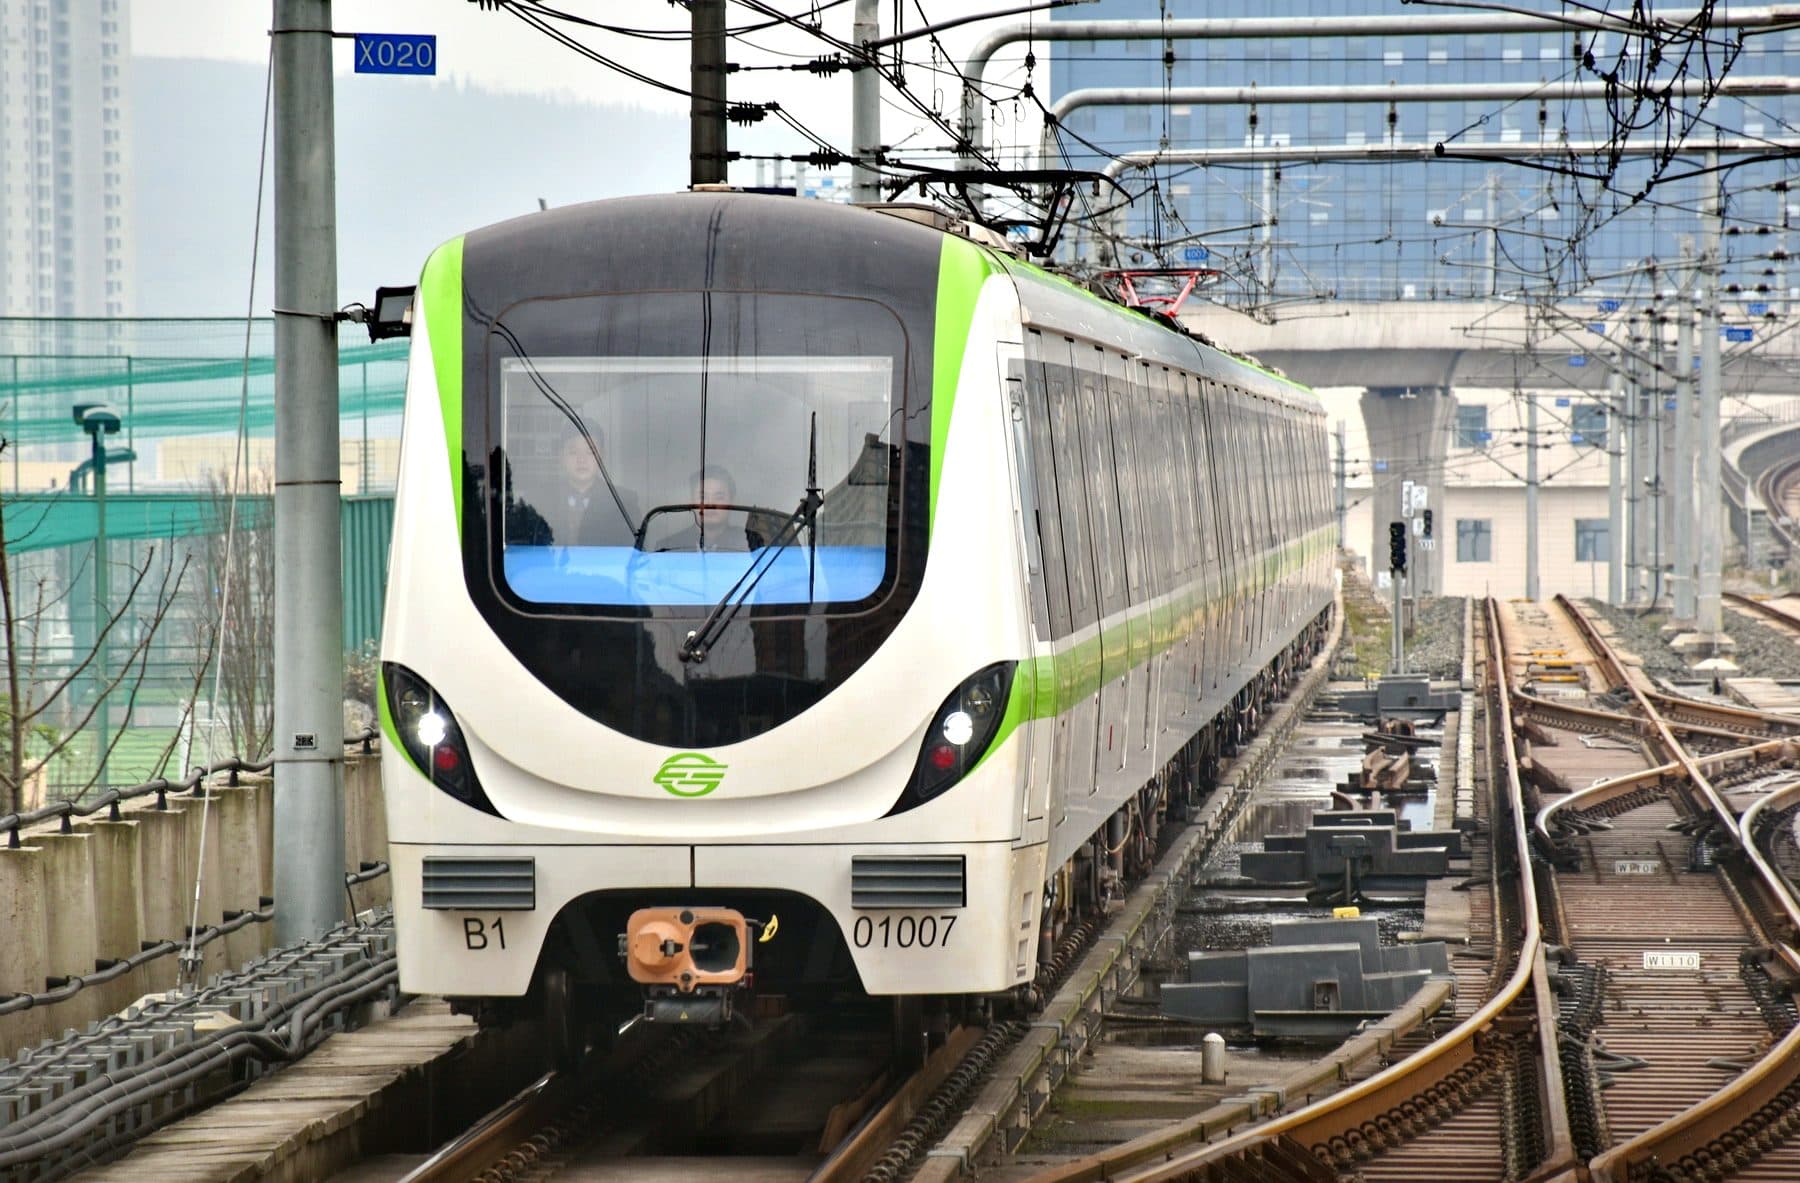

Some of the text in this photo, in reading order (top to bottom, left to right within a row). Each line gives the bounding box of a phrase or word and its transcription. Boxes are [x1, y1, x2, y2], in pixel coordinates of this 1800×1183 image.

[359, 40, 433, 67] X020
[463, 916, 505, 950] B1
[853, 915, 957, 948] 01007
[1648, 956, 1695, 966] W1110
